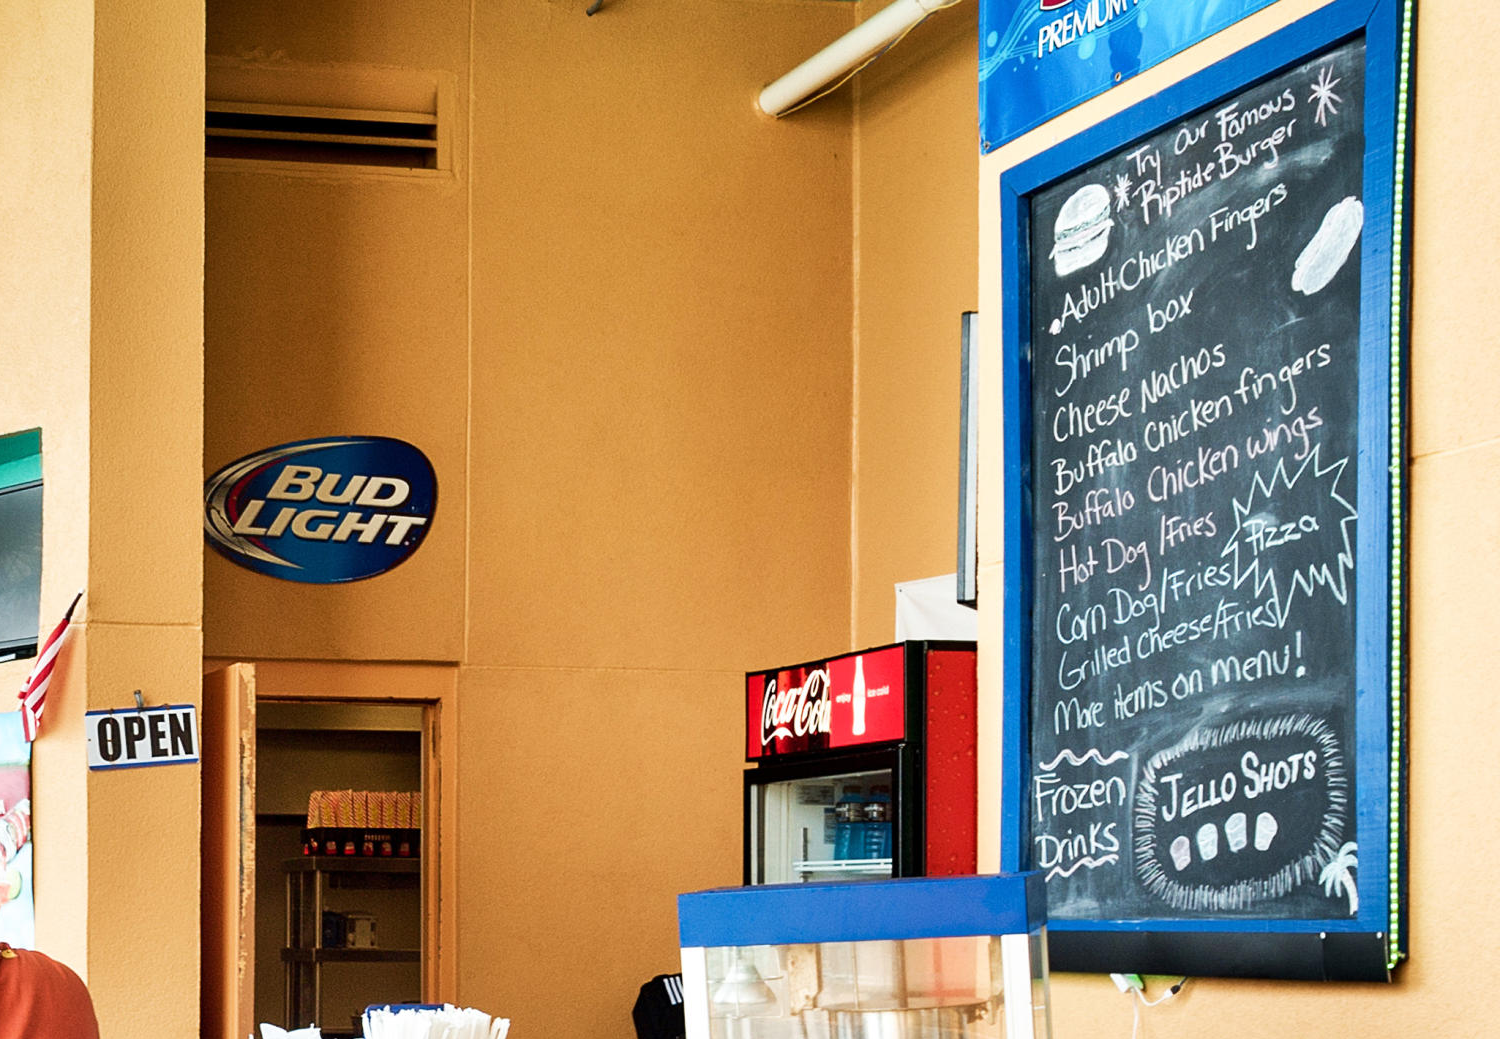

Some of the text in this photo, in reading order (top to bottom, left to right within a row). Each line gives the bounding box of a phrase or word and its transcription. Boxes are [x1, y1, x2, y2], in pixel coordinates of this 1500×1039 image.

[1126, 145, 1161, 185] Try
[1215, 88, 1295, 141] Famous
[1132, 119, 1297, 224] Riptide Burger
[1061, 183, 1288, 328] Adult Chicken Fingers
[1055, 288, 1194, 397] Shrimp box
[1051, 439, 1137, 496] Buffalo
[1235, 344, 1331, 415] fingers
[1053, 344, 1226, 442] Cheese Nachos
[266, 465, 410, 508] BUD
[1052, 407, 1323, 542] Buffalo Chicken wings
[233, 500, 428, 546] LIGHT
[1242, 515, 1320, 555] Pizza
[1059, 544, 1099, 593] Hot
[1101, 538, 1150, 592] Dog
[1057, 603, 1107, 645] Corn
[1059, 635, 1131, 690] Grilled
[761, 669, 831, 746] Coca-Cola
[1055, 697, 1106, 735] More
[1114, 680, 1168, 720] items
[1172, 669, 1203, 699] on
[97, 712, 194, 762] OPEN
[1034, 773, 1127, 822] Frozen
[1160, 750, 1317, 822] JELLO SHOTS
